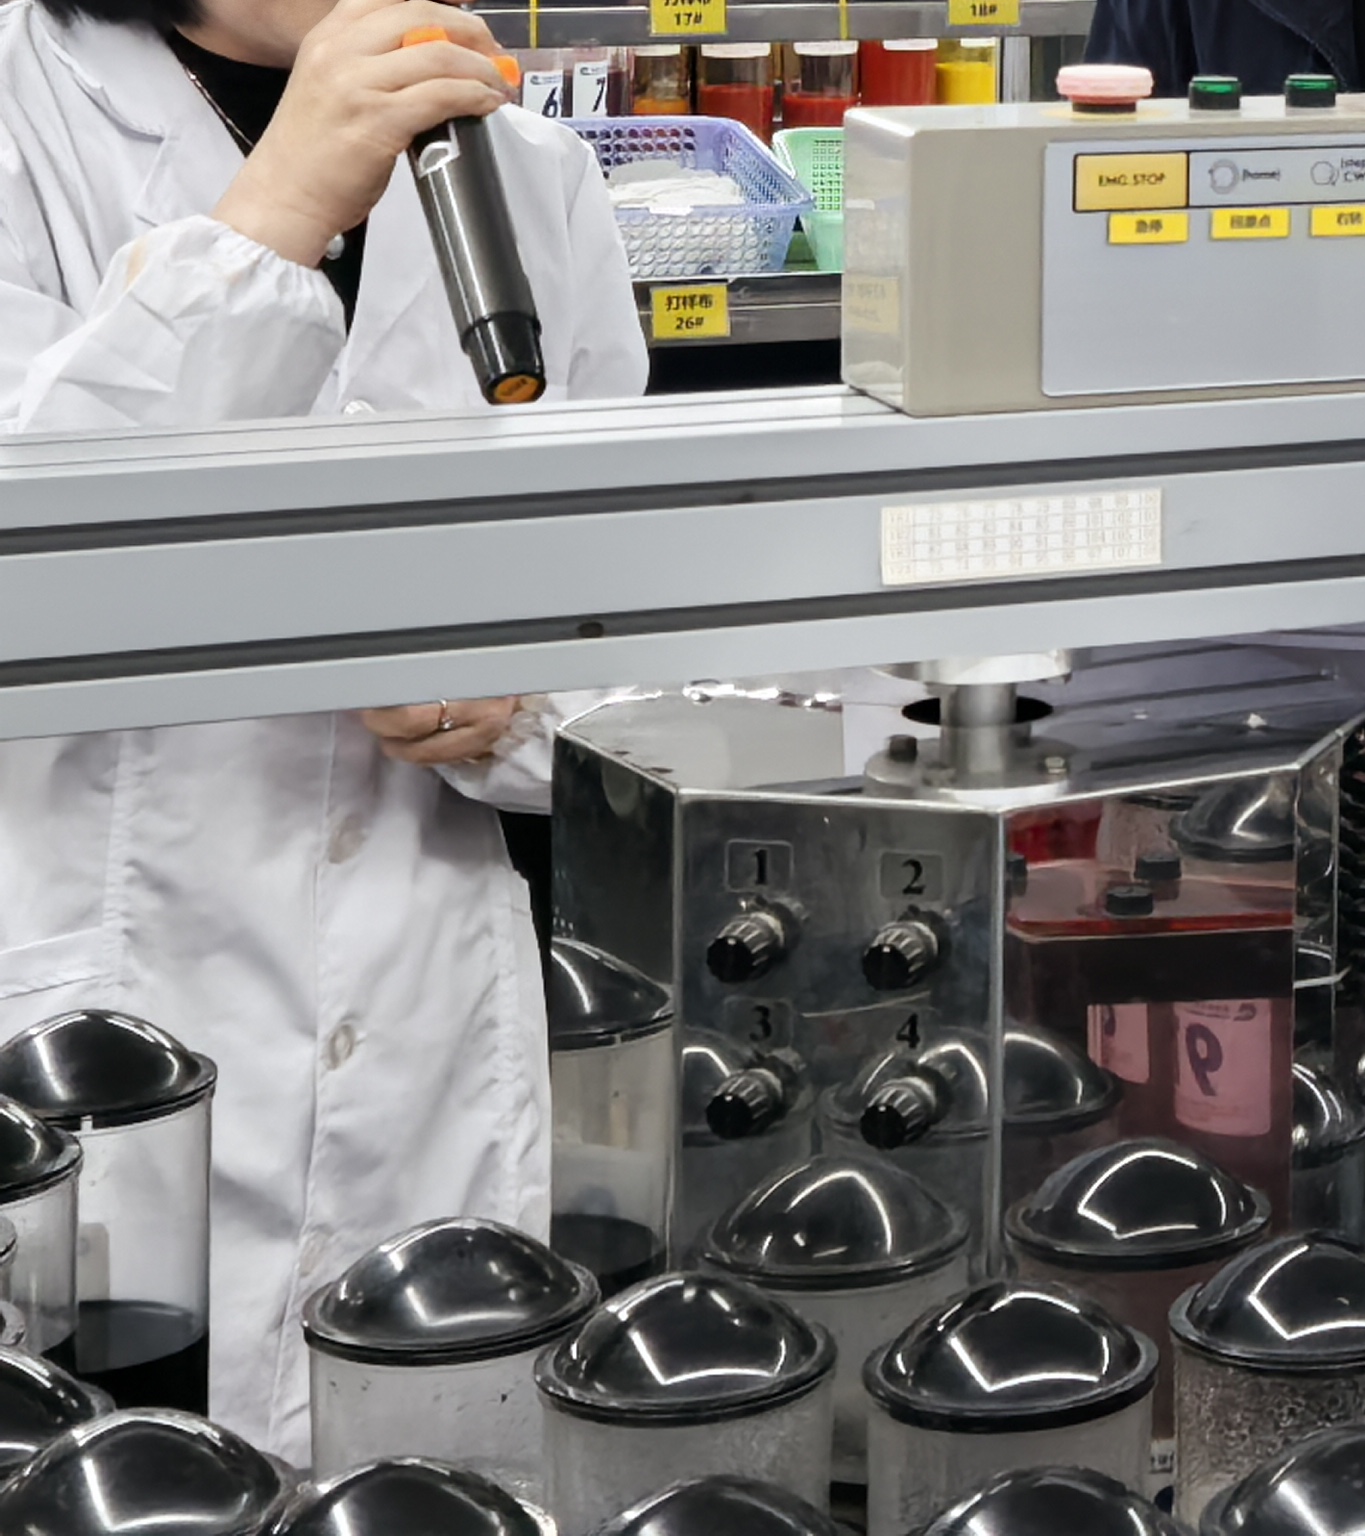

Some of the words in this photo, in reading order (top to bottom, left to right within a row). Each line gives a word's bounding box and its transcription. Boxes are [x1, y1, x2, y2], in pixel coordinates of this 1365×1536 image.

[674, 12, 702, 26] 17#
[970, 4, 998, 17] 18#
[542, 86, 559, 119] 6
[592, 77, 606, 113] 7
[1133, 172, 1167, 186] STOP
[665, 294, 713, 312] 打样布
[676, 317, 704, 331] 26#
[754, 849, 767, 886] 1
[902, 859, 926, 895] 2
[749, 1005, 771, 1042] 3
[896, 1013, 921, 1049] 4
